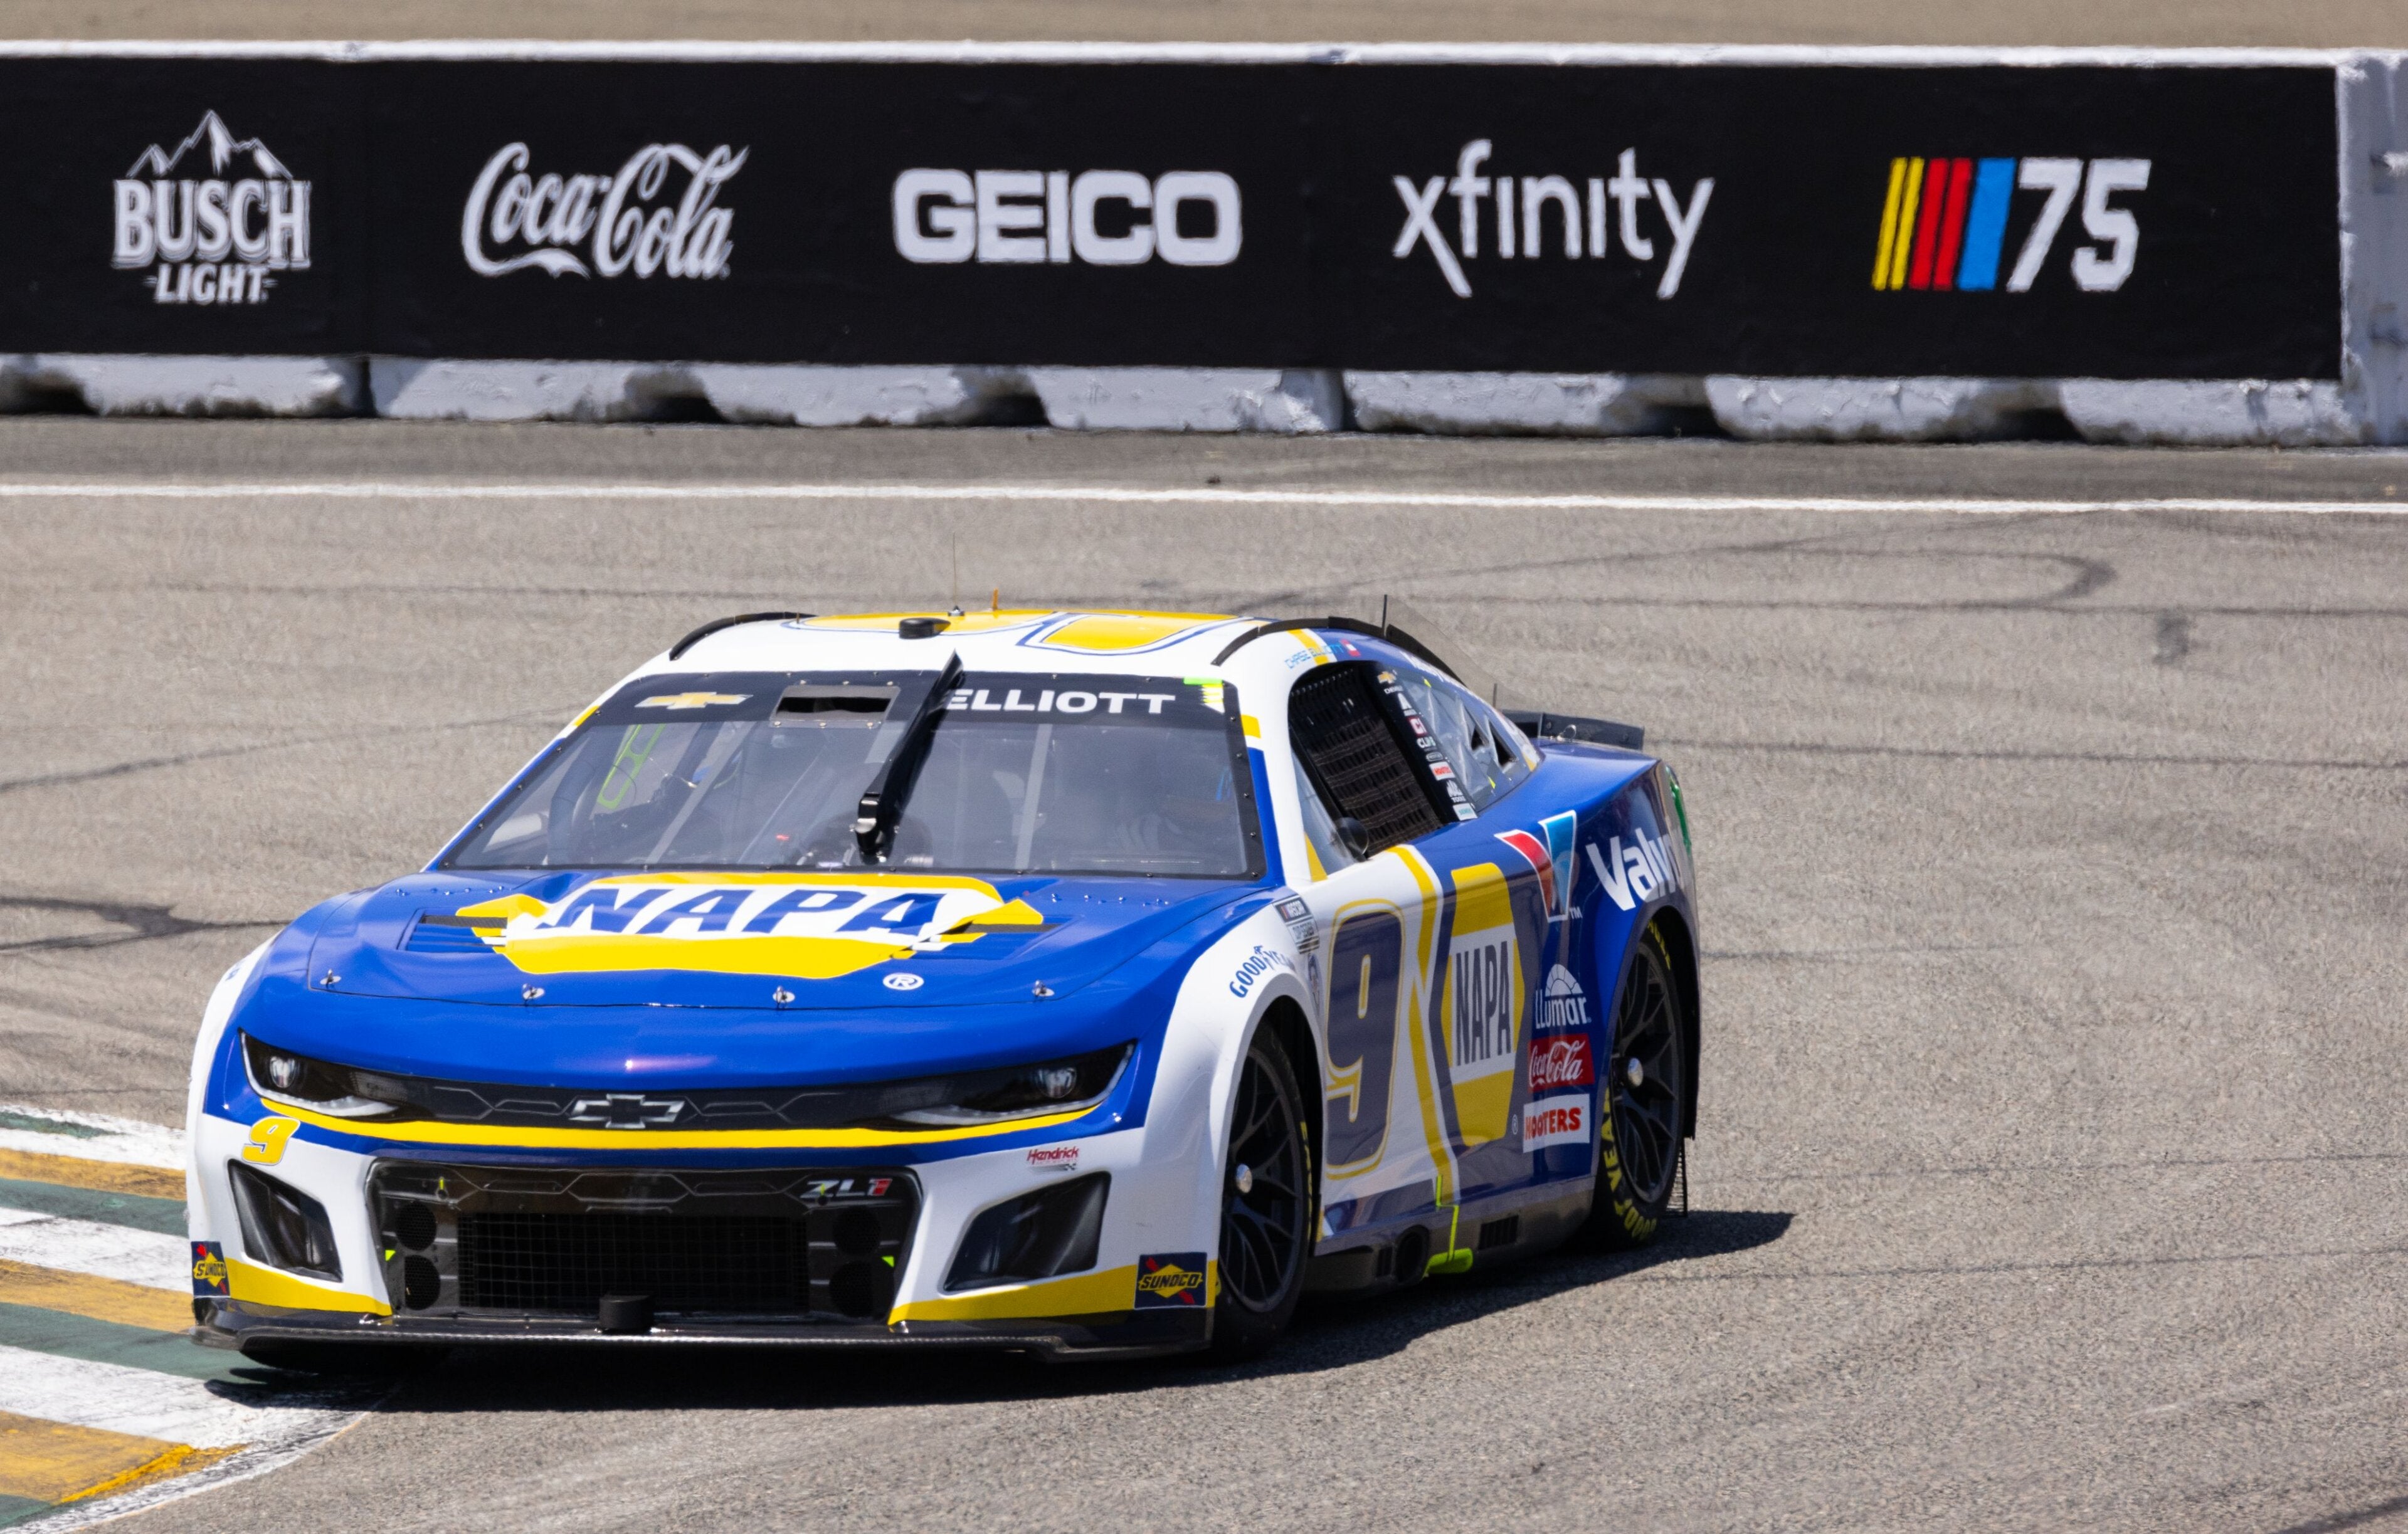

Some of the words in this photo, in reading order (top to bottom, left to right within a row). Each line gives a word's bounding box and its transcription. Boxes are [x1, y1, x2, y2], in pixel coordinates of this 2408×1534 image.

[112, 178, 311, 270] BUSCH
[462, 142, 749, 278] Coca-Cola
[893, 168, 1242, 266] GEICO
[1393, 139, 1714, 298] xfinity
[2008, 158, 2152, 292] 75
[154, 263, 268, 305] LIGHT
[946, 688, 1176, 714] ELLIOTT
[534, 889, 947, 935] NAPA
[1455, 940, 1513, 1067] NAPA
[1326, 898, 1406, 1180] 9
[1528, 1039, 1586, 1088] Coca-Cola
[241, 1116, 301, 1165] 9
[1524, 1106, 1582, 1141] HOOTERS
[1027, 1145, 1080, 1165] Hendrick
[1140, 1273, 1201, 1290] SUNOCO
